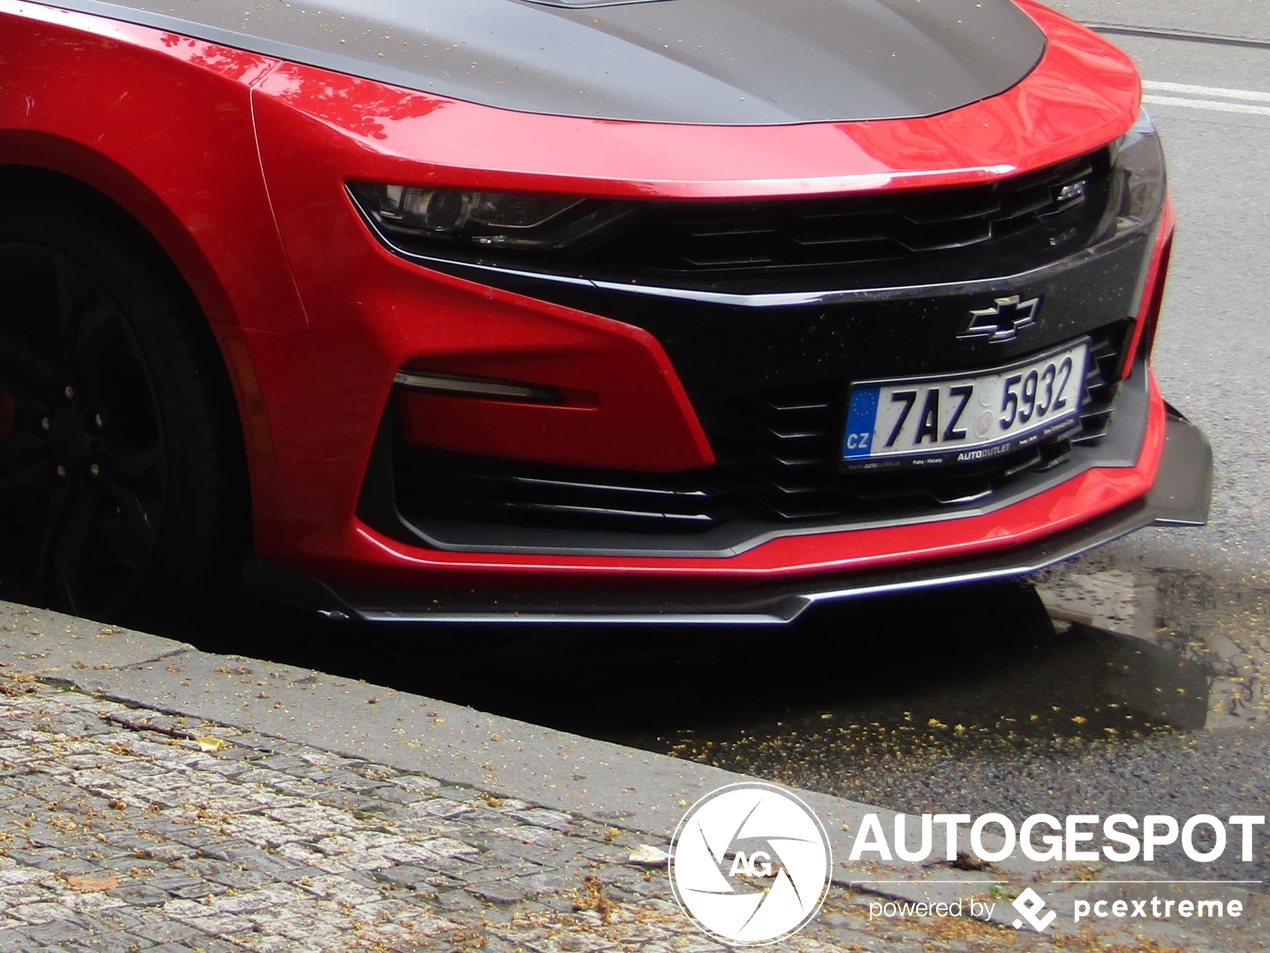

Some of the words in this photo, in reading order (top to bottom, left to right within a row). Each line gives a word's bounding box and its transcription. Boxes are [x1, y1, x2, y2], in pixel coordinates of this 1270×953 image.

[885, 385, 974, 448] 7AZ
[999, 356, 1073, 430] 5932
[847, 432, 870, 449] CZ
